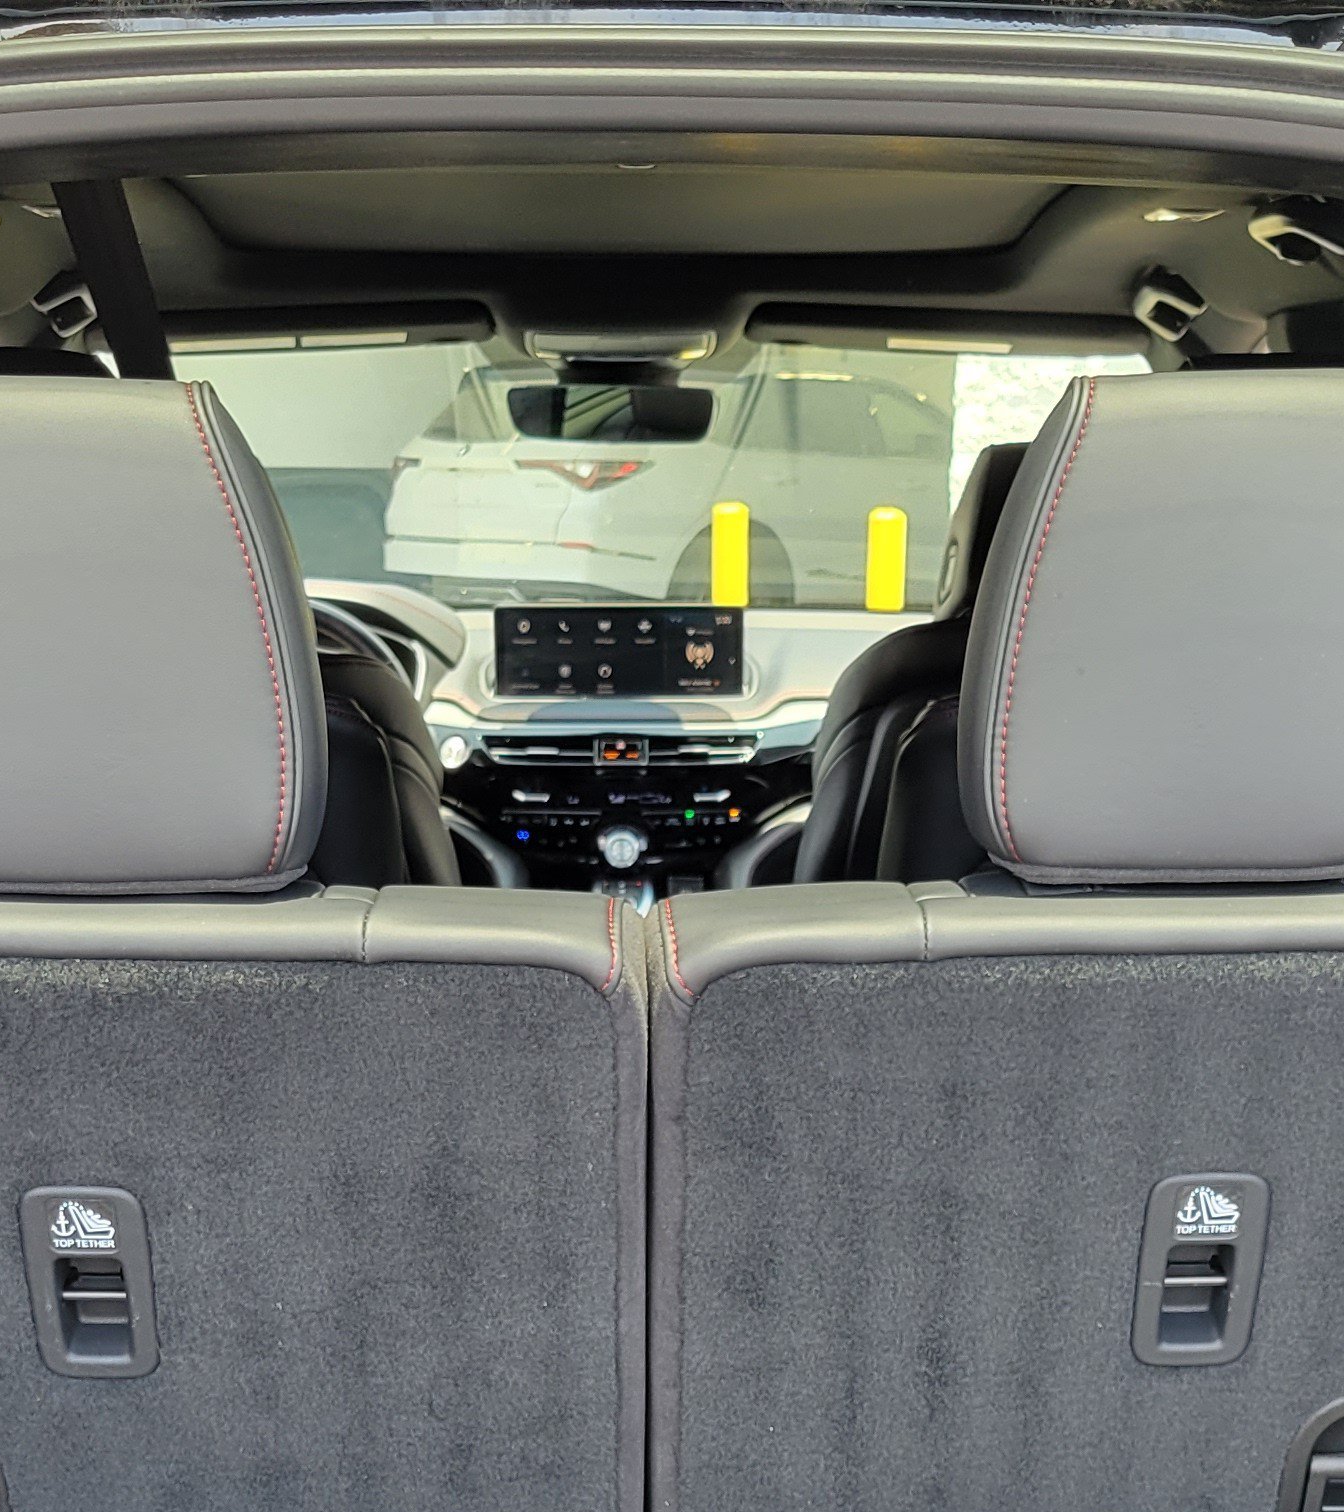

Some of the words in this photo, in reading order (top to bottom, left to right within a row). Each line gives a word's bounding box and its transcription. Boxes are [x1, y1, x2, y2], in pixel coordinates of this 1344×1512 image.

[1176, 1224, 1197, 1235] TOP
[1197, 1223, 1237, 1234] TETHER
[53, 1238, 75, 1249] TOP
[75, 1238, 116, 1249] TETHER
